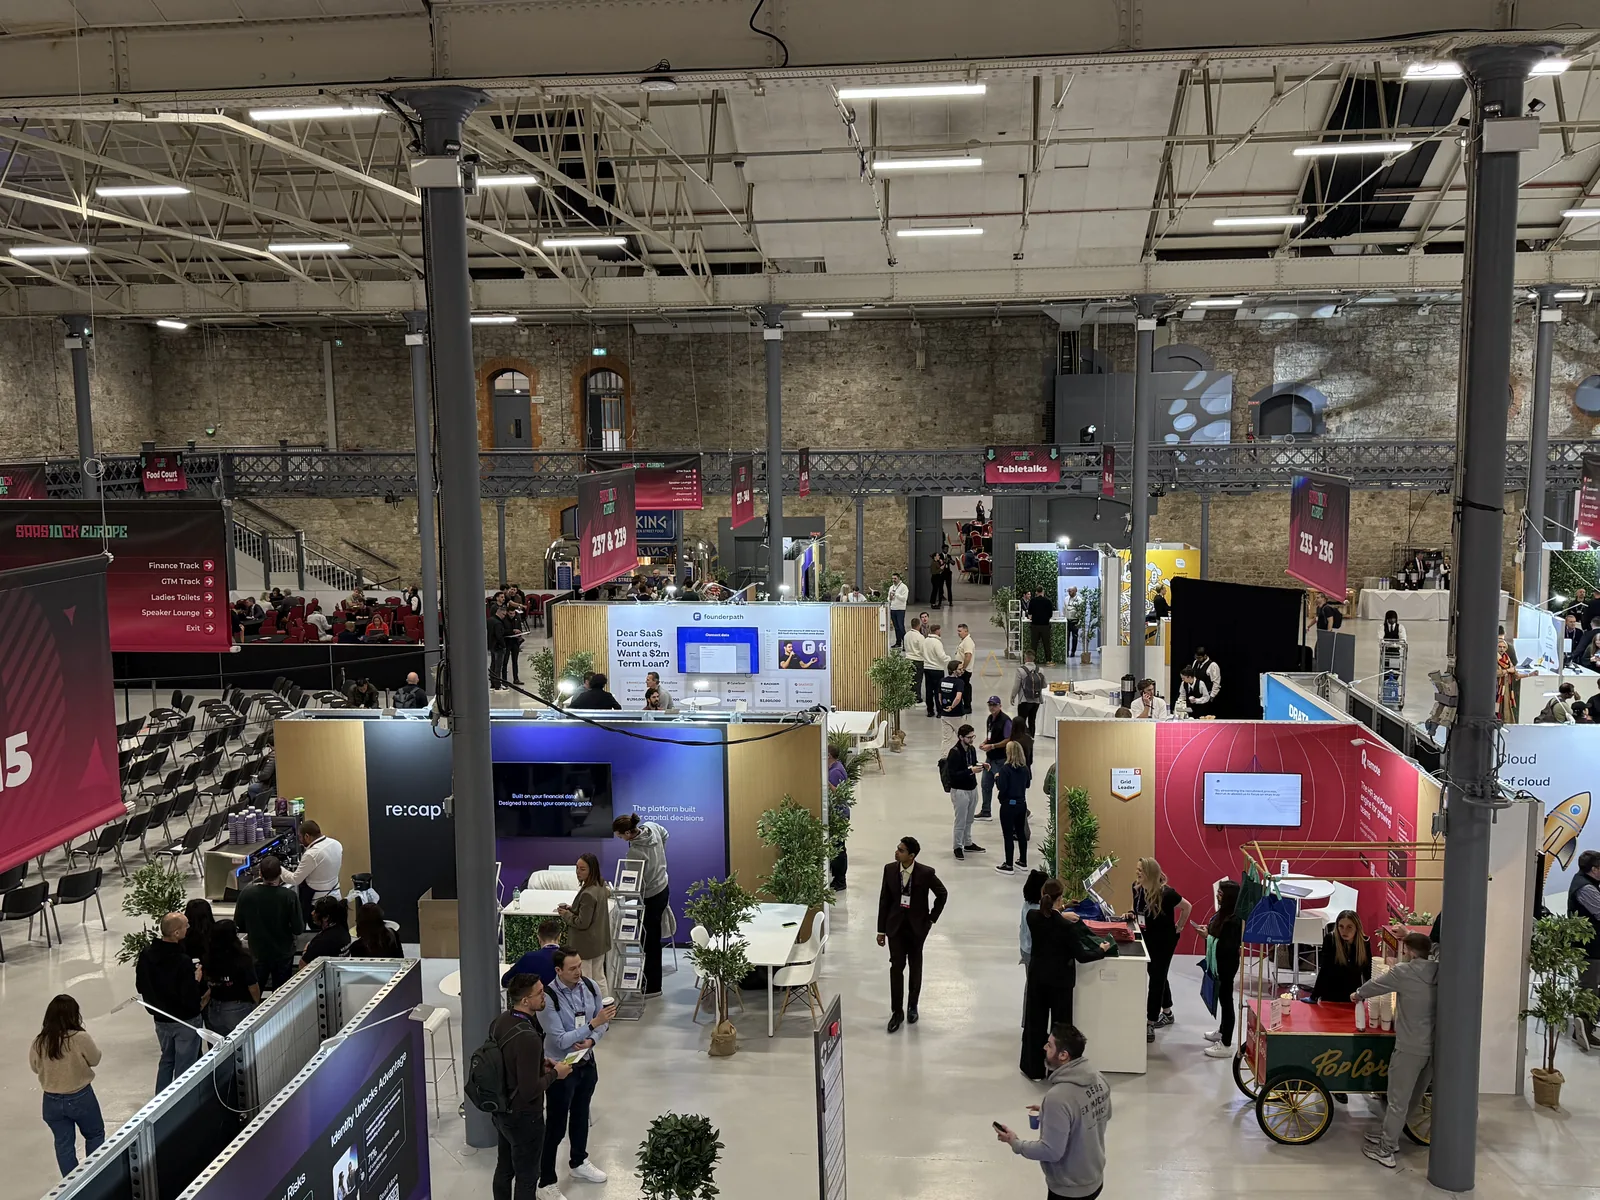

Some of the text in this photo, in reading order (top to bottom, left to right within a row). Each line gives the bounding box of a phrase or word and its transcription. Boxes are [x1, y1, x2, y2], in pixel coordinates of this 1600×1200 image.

[146, 471, 160, 479] Food
[997, 465, 1048, 473] Tabletalks
[80, 525, 128, 538] EUROPE
[592, 526, 627, 557] 237 & 239
[1300, 531, 1312, 556] 233
[1319, 538, 1334, 564] 236
[142, 609, 171, 617] Speaker
[640, 629, 663, 637] SaaS
[649, 649, 670, 658] $2m
[1367, 759, 1380, 776] remote
[1518, 777, 1550, 786] cloud
[386, 803, 441, 820] re:cap
[1086, 1084, 1103, 1098] DEUS
[331, 1114, 354, 1148] Identity
[354, 1086, 378, 1118] Unlocks
[378, 1052, 407, 1091] Advantage
[287, 1173, 306, 1198] Risks
